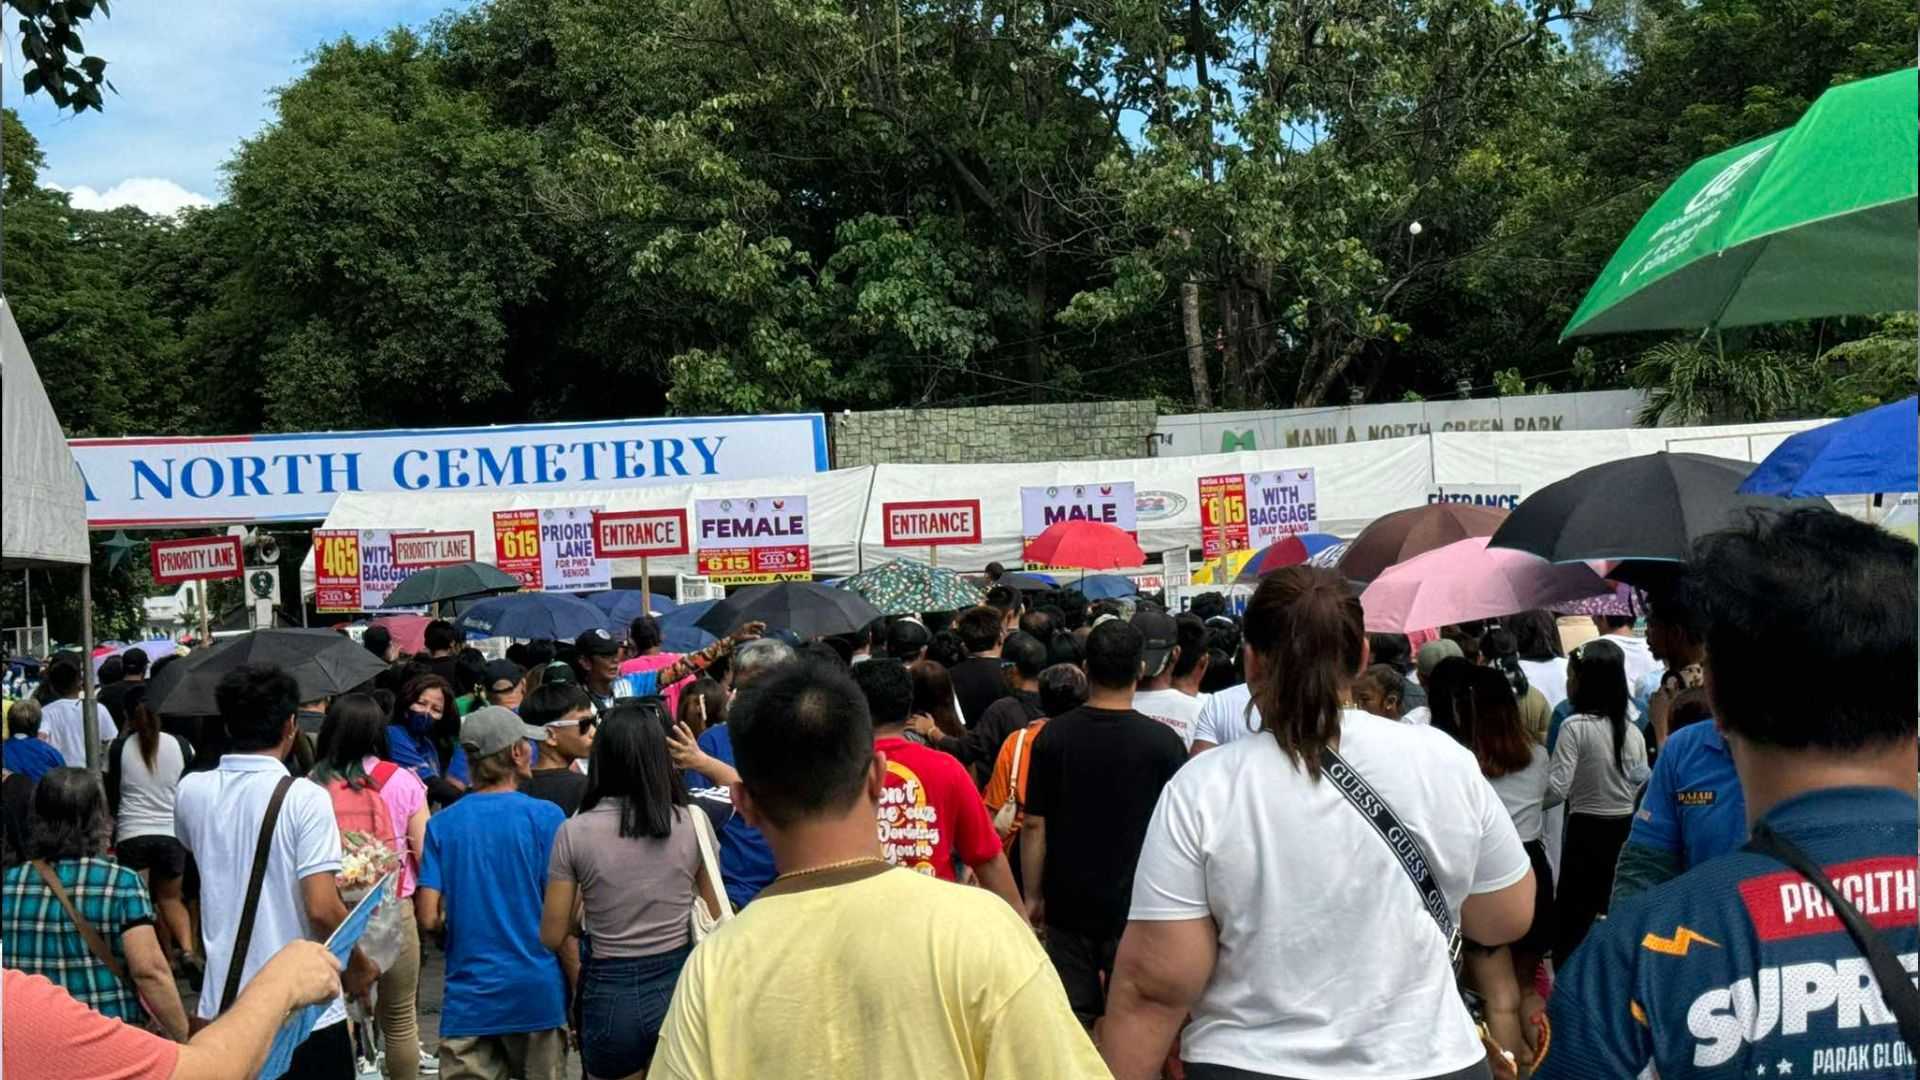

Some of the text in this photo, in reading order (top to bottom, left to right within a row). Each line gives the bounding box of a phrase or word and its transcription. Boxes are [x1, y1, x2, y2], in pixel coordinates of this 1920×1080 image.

[1514, 415, 1564, 431] PARK
[130, 452, 364, 501] NORTH
[393, 436, 727, 491] CEMETERY
[1263, 485, 1299, 505] WITH
[892, 512, 969, 535] ENTRANCE
[1044, 503, 1118, 526] MALE
[1249, 503, 1317, 526] BAGGAGE
[542, 523, 593, 542] PRIORIT
[602, 521, 675, 547] ENTRANCE
[702, 515, 804, 539] FEMALE
[160, 547, 235, 572] PRIORITY LANE
[362, 546, 392, 564] WITH
[397, 539, 468, 560] PRIORITY LANE
[557, 540, 593, 559] LANE
[562, 568, 590, 578] SENIOR
[709, 574, 768, 584] anawe
[1329, 762, 1384, 818] GUESS
[1387, 826, 1429, 883] GUESS
[1780, 869, 1917, 923] PRCLTH
[1812, 1044, 1869, 1075] PARAK
